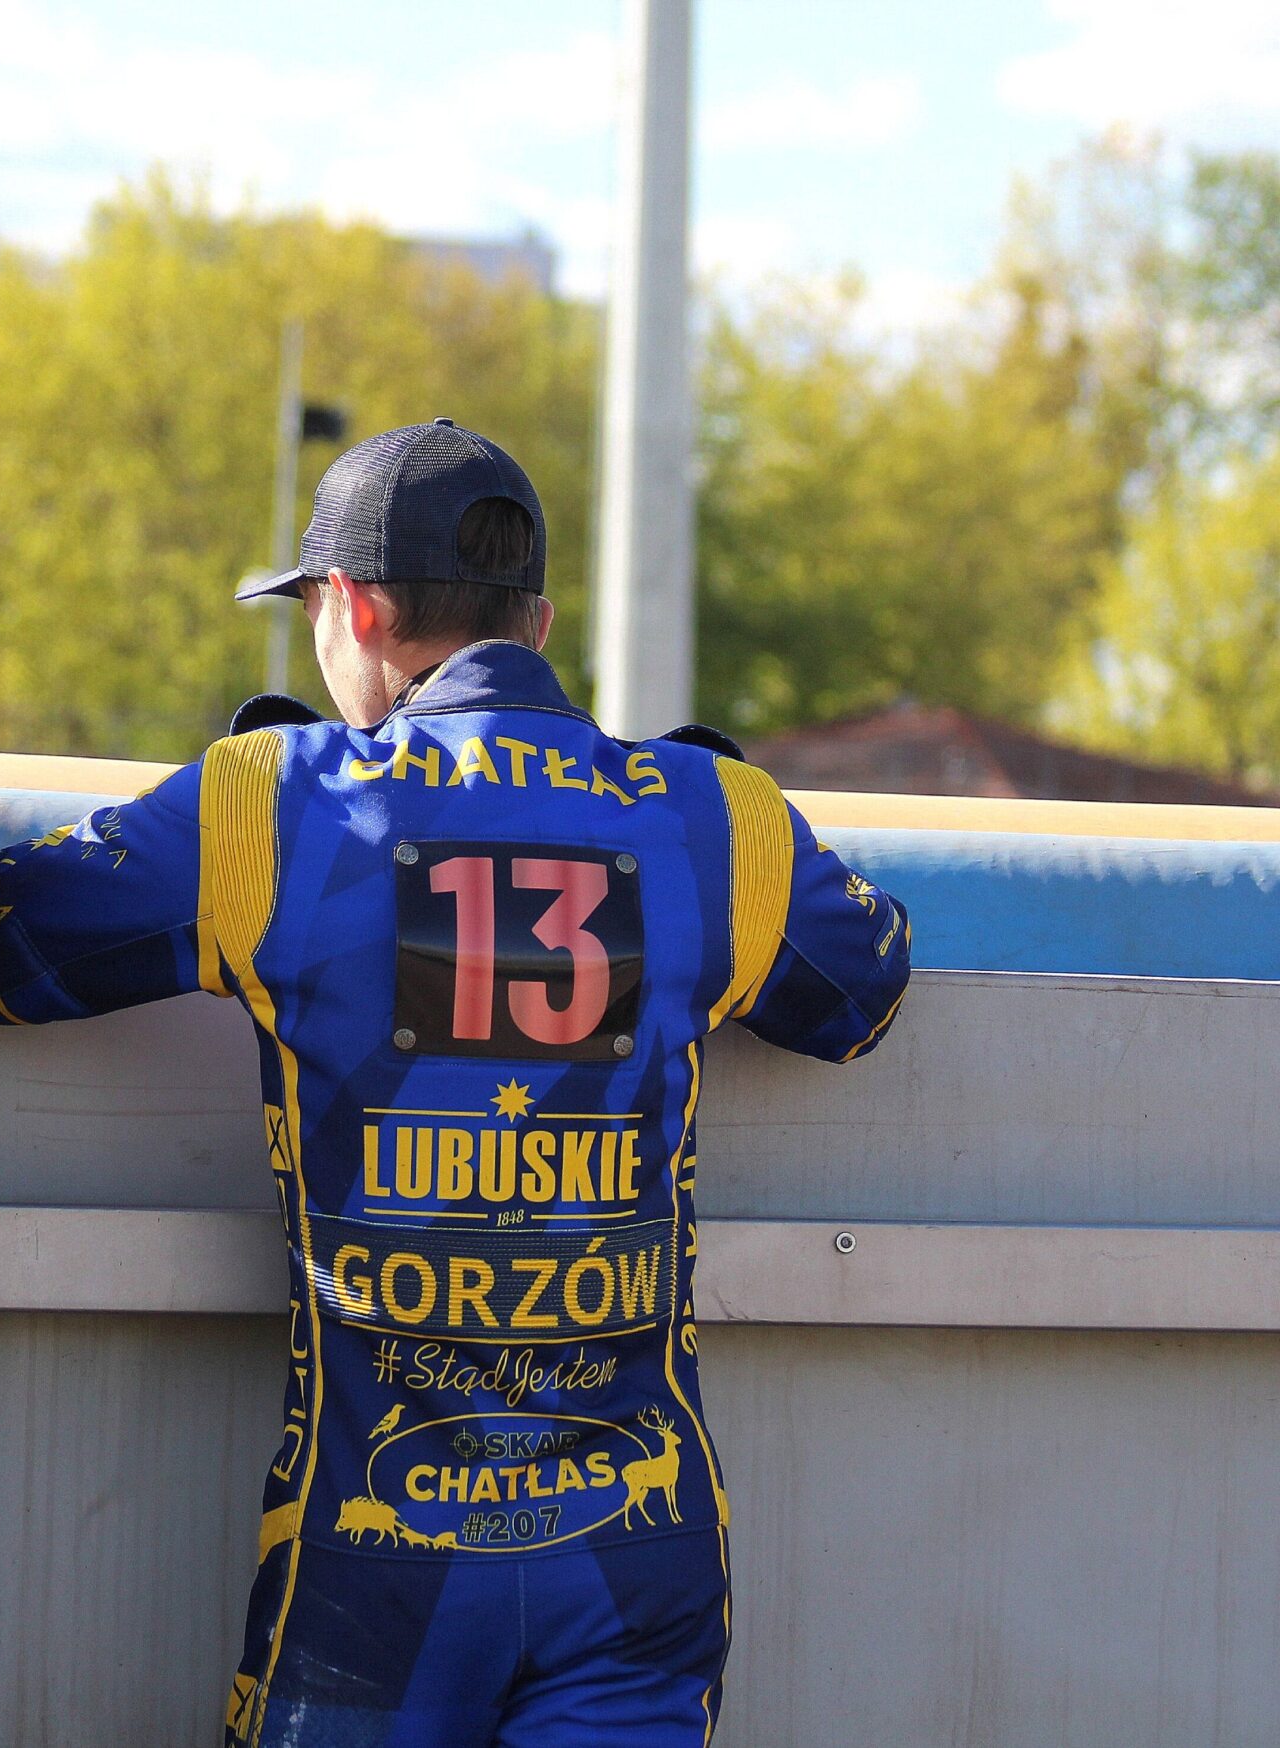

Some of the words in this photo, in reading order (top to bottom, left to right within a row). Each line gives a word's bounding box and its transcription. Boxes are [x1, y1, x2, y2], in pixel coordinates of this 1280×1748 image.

[428, 856, 610, 1045] 13
[363, 1124, 642, 1202] LUBUSKIE
[496, 1209, 525, 1227] 1848
[332, 1236, 662, 1328] GORZÓW
[372, 1339, 617, 1408] #StądJestem
[404, 1452, 617, 1504] CHATŁAS
[461, 1504, 562, 1543] #207
